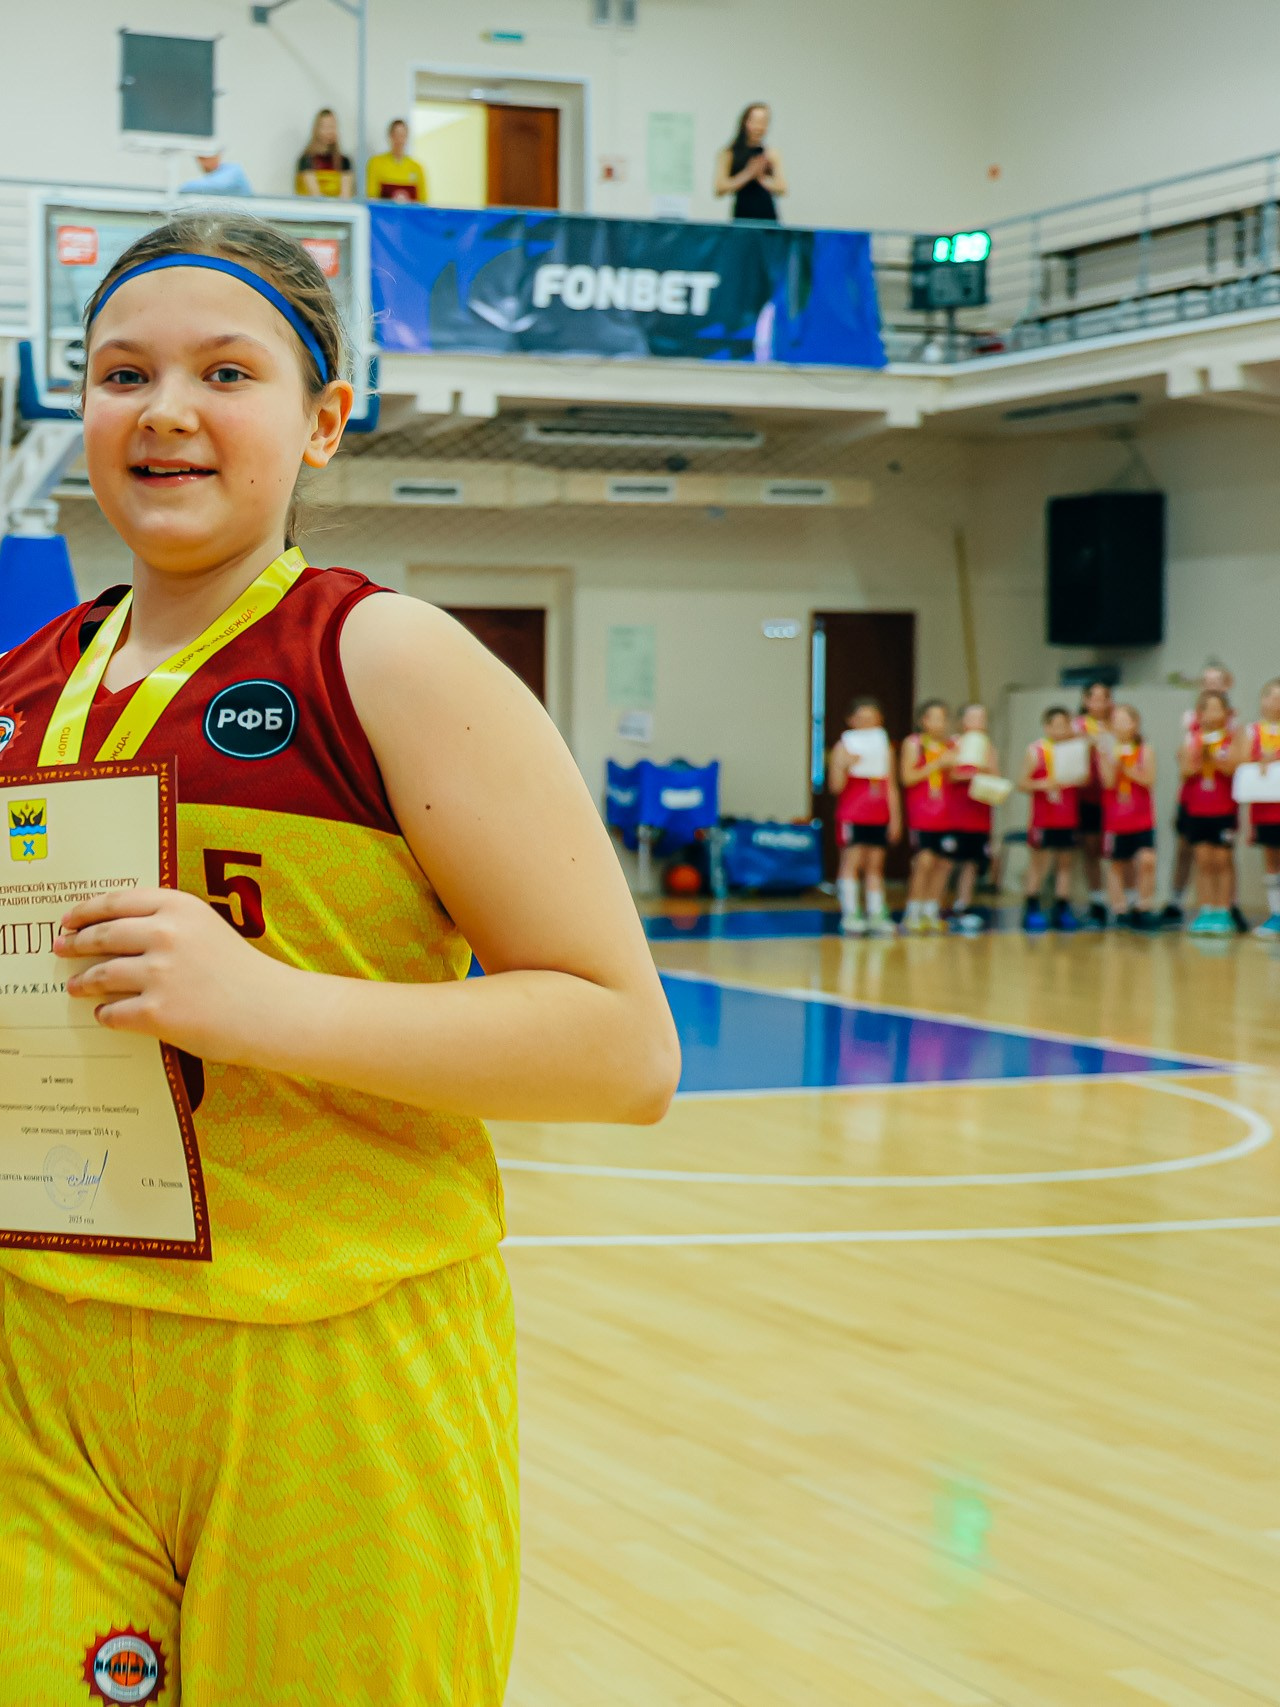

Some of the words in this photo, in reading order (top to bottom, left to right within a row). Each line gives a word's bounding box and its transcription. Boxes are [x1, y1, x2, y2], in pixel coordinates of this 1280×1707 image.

[532, 263, 720, 317] FONBET
[217, 708, 283, 730] РФБ
[46, 881, 88, 893] КУЛЬТУРЕ
[90, 879, 97, 889] И
[99, 878, 139, 889] СПОРТУ
[31, 893, 63, 905] ГОРОДА
[23, 1173, 54, 1183] комитета
